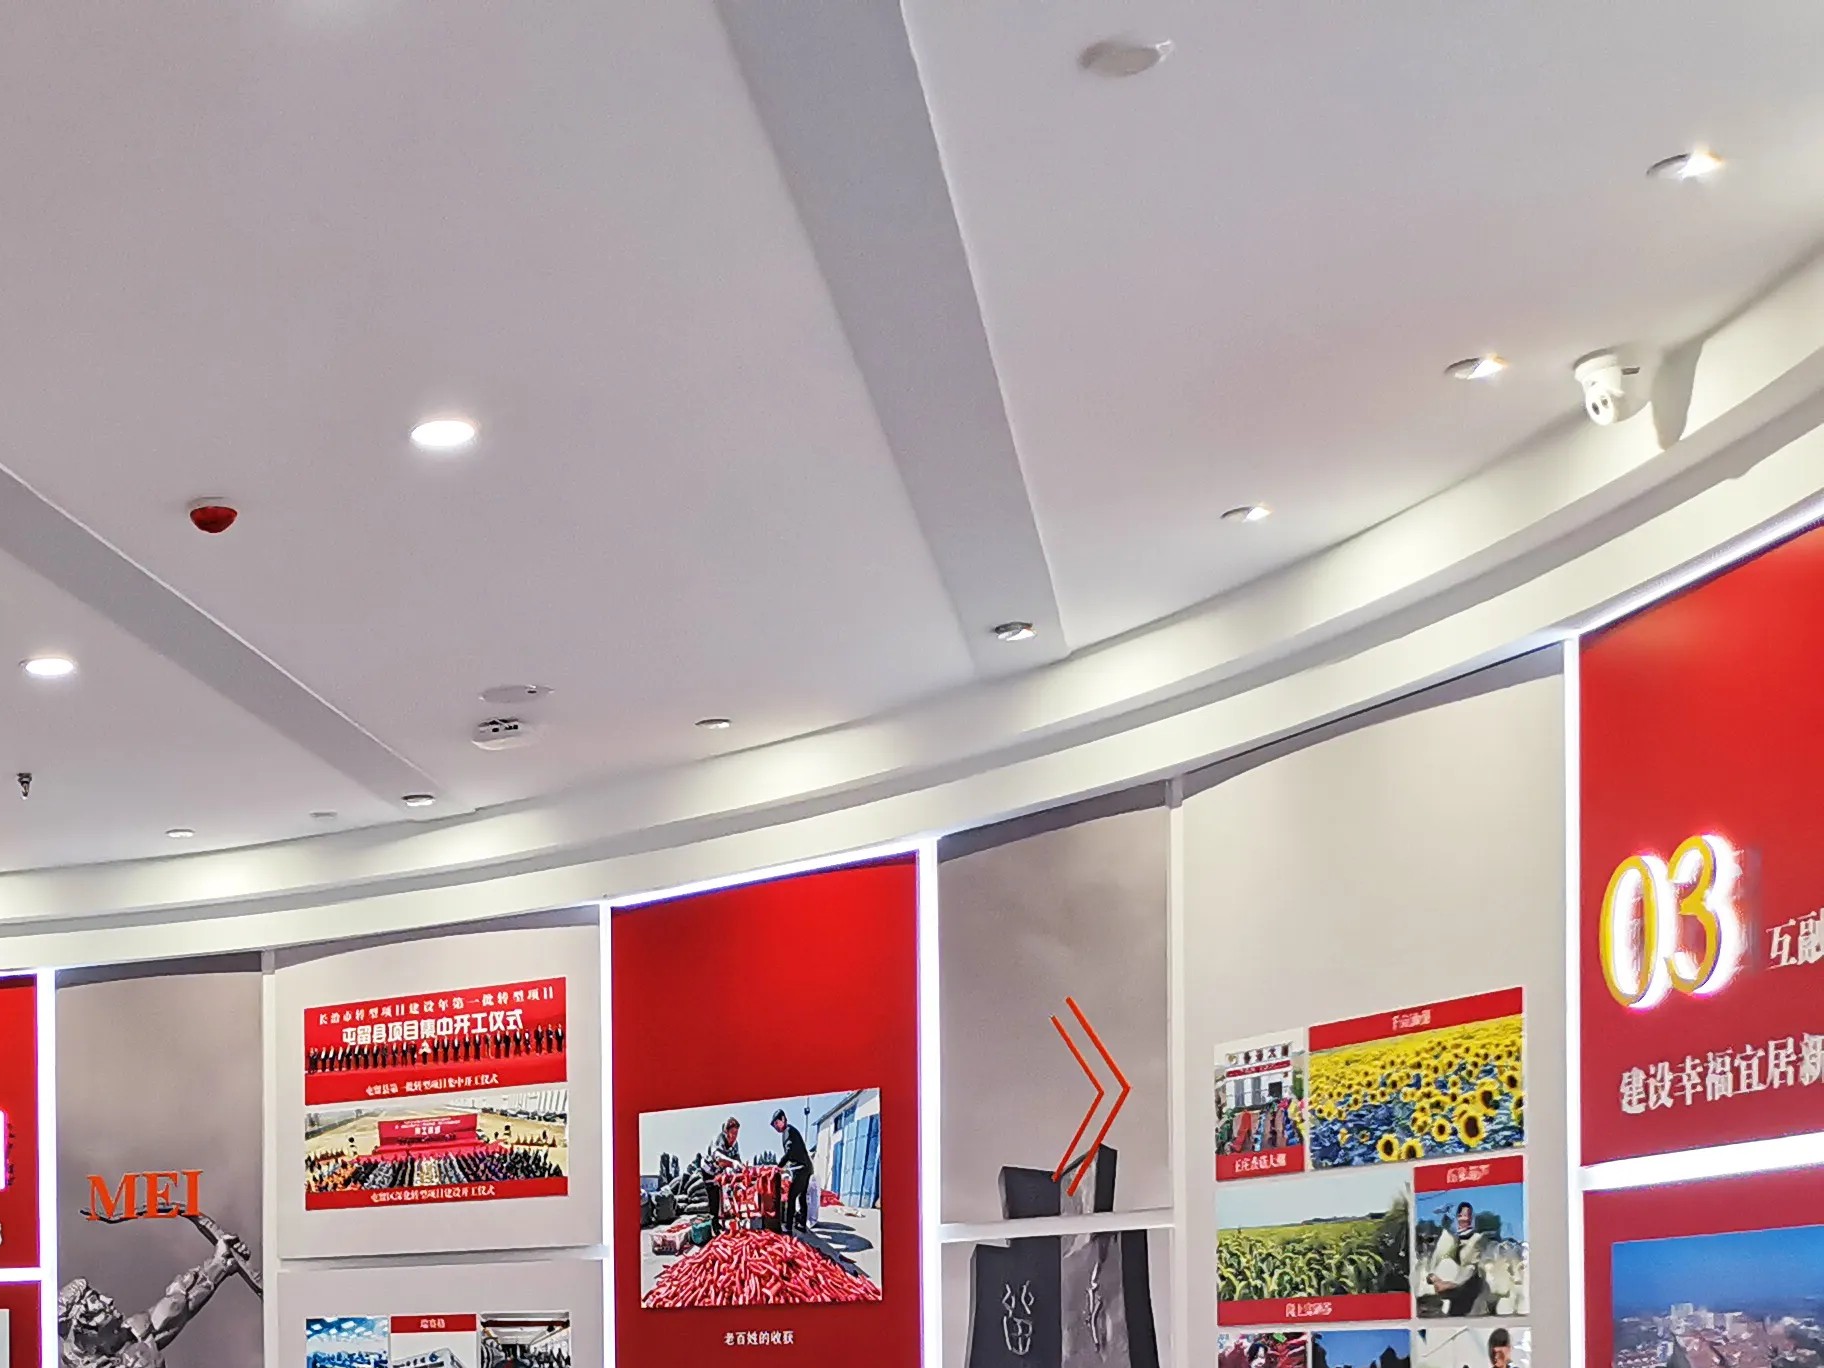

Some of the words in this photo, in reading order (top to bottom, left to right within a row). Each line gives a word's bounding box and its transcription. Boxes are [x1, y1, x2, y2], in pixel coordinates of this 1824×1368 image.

[1599, 835, 1736, 1007] 03
[342, 1009, 524, 1046] 屯留县项目集中开工仪式
[1619, 1032, 1824, 1114] 建设幸福宜居新
[85, 1169, 204, 1221] MEI
[724, 1330, 794, 1346] 老百姓的收获
